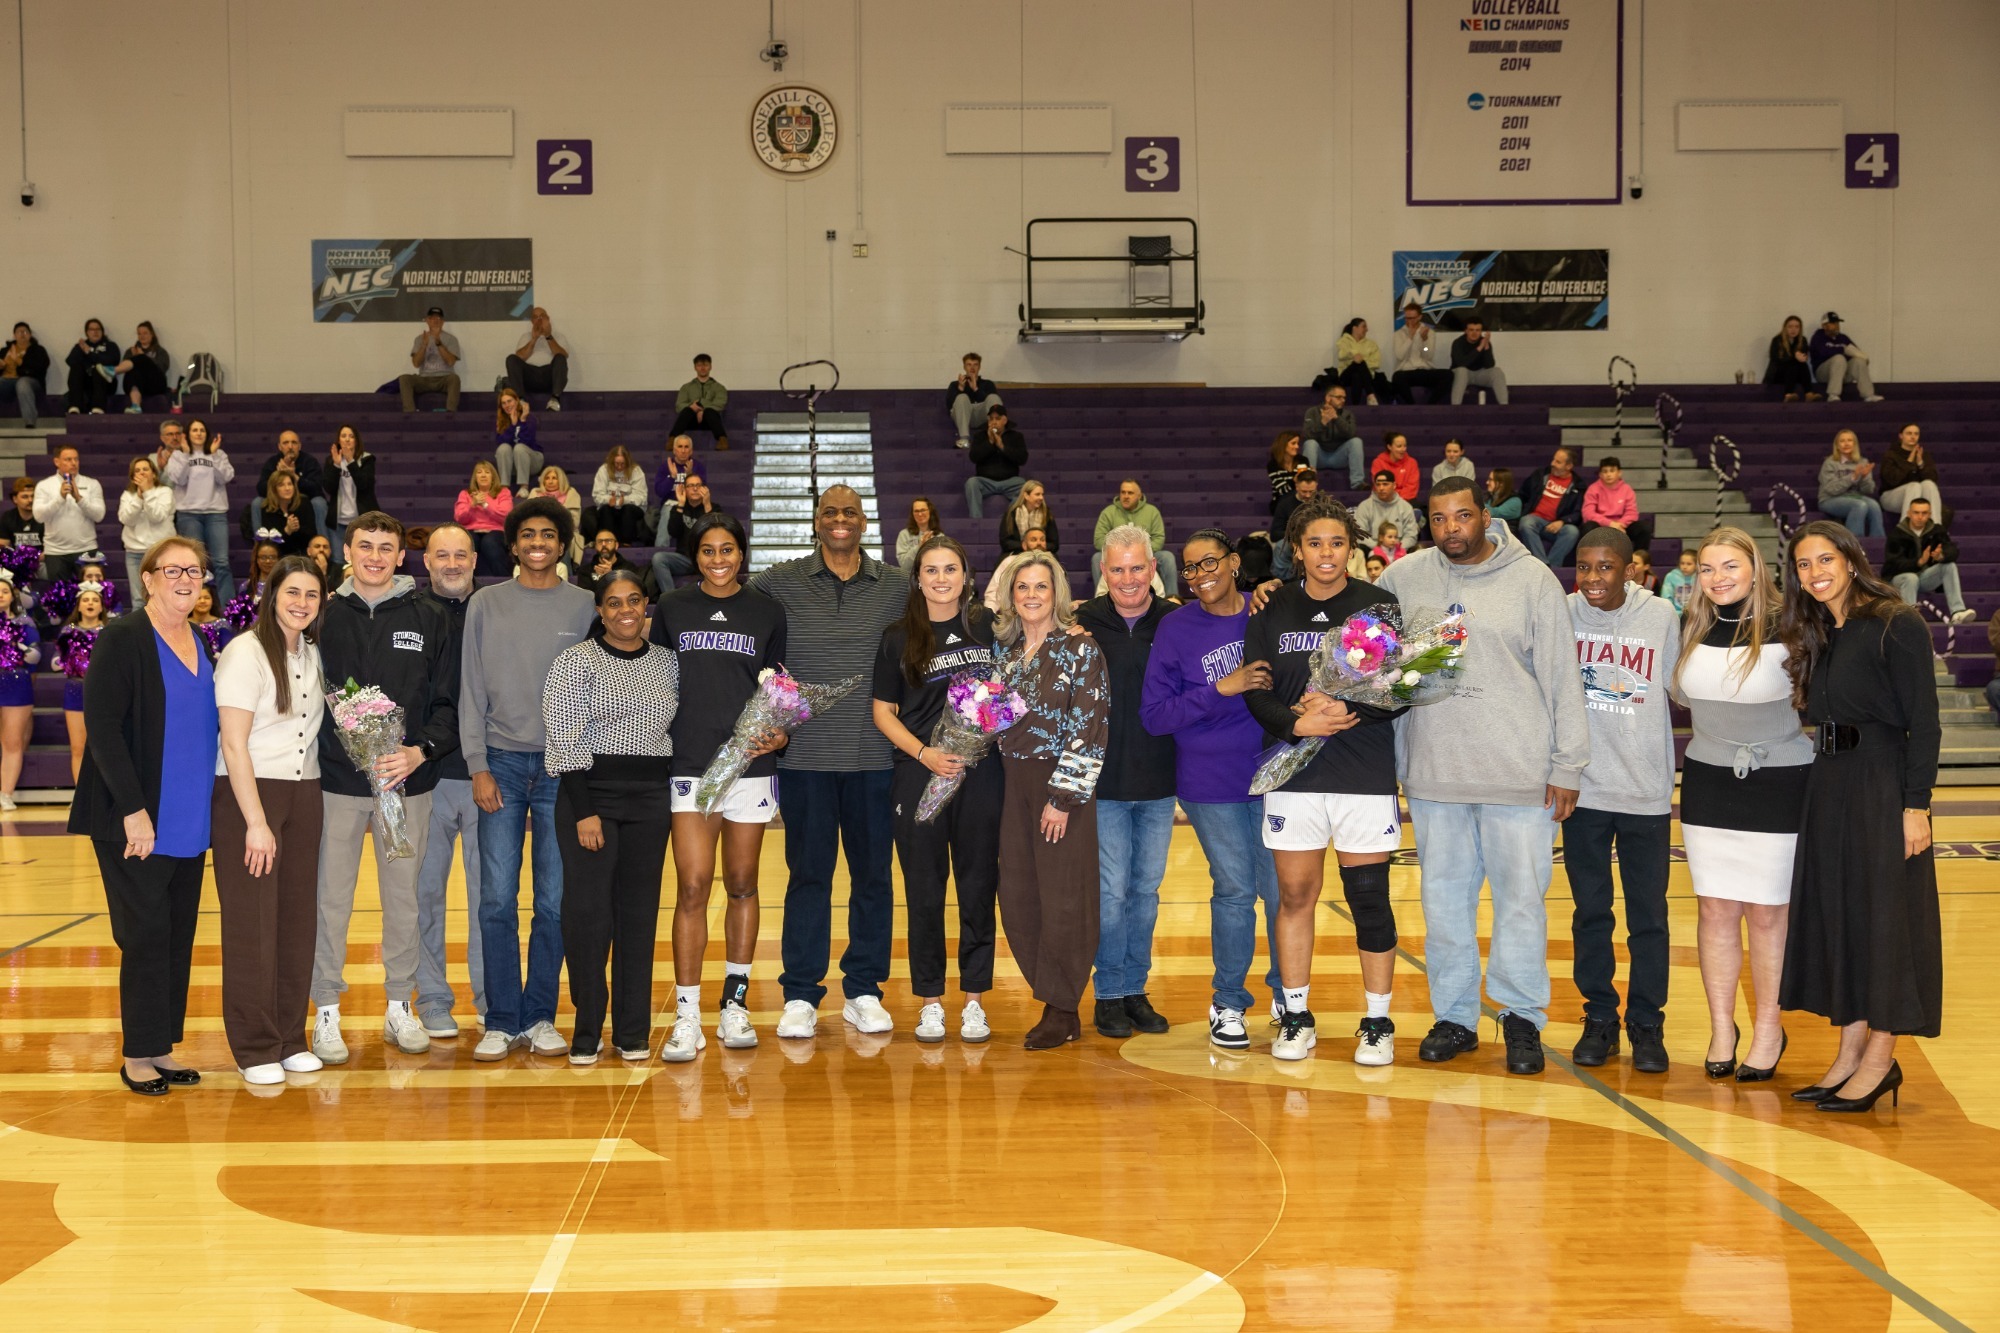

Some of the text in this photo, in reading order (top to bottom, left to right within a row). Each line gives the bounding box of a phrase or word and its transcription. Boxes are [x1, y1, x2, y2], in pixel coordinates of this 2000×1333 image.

[1472, 0, 1560, 15] VOLLEYBALL
[1460, 19, 1570, 31] NE10 CHAMPIONS
[1500, 58, 1531, 71] 2014
[1488, 96, 1562, 108] TOURNAMENT
[756, 92, 834, 163] STONEHILL COLLEGE
[1501, 116, 1529, 129] 2011
[1500, 137, 1531, 150] 2014
[548, 150, 583, 184] 2
[1136, 147, 1169, 182] 3
[1499, 158, 1531, 171] 2021
[1855, 144, 1889, 178] 4
[327, 250, 390, 258] NORTHEAST
[1407, 261, 1470, 269] NORTHEAST
[1407, 268, 1468, 276] CONFERENCE
[320, 265, 394, 298] NEC
[402, 269, 530, 286] NORTHEAST CONFERENCE
[1402, 276, 1474, 306] NEC
[1480, 280, 1607, 296] NORTHEAST CONFERENCE
[392, 631, 424, 645] STONEHILL
[679, 631, 756, 656] STONEHILL
[1279, 631, 1327, 654] STONE
[1588, 634, 1623, 644] SUNSHIE
[1624, 637, 1646, 646] STATE
[923, 652, 966, 675] TONEHILL
